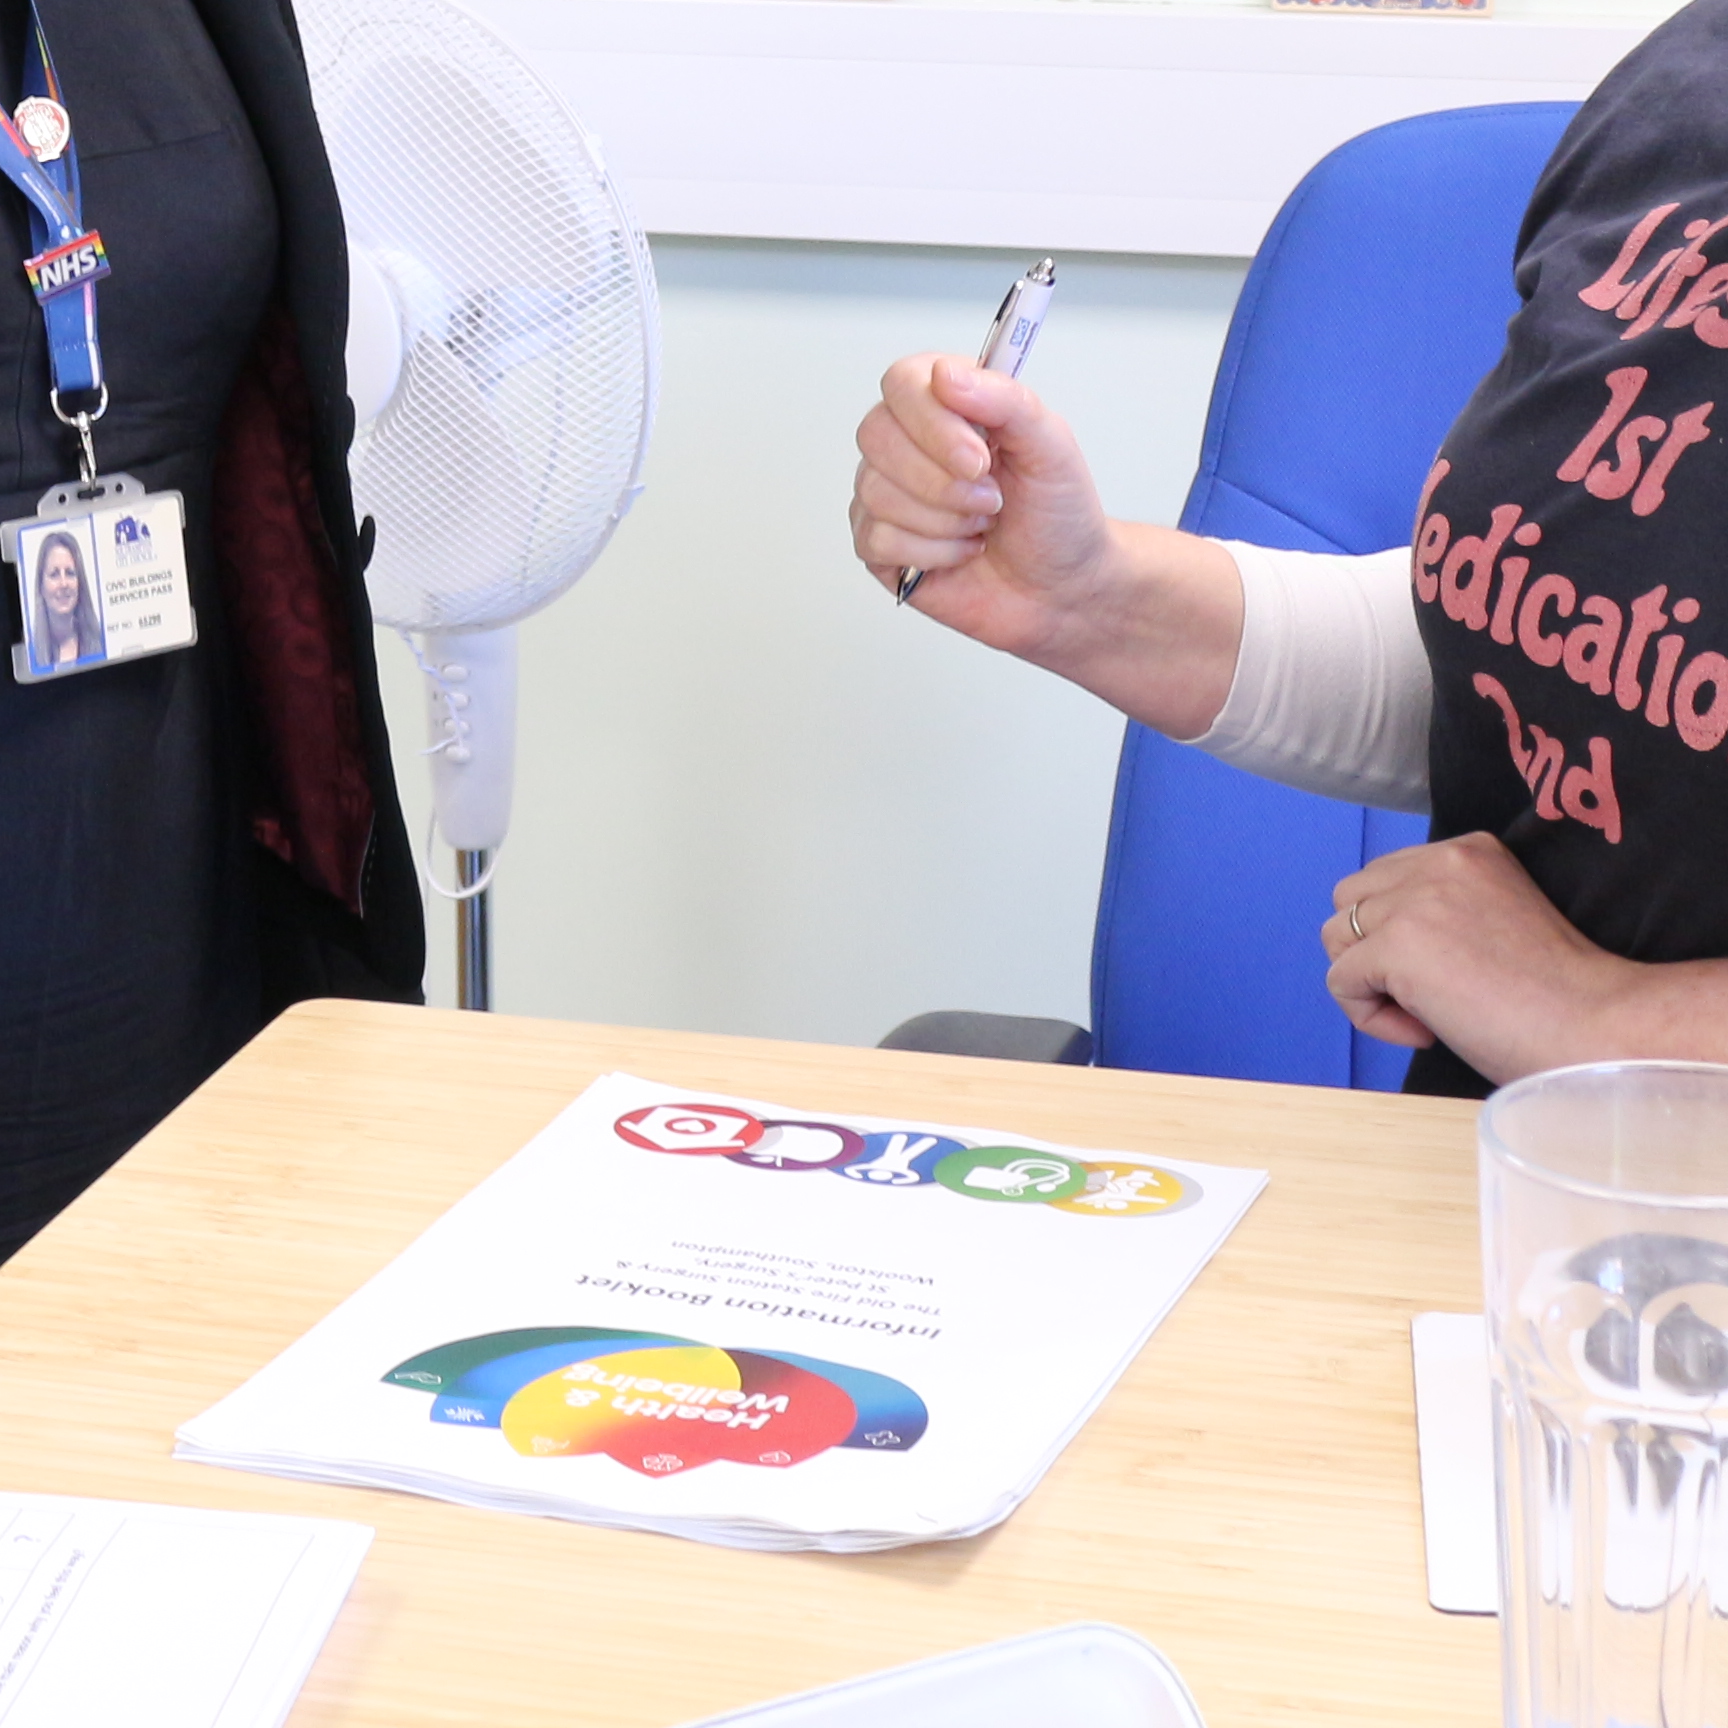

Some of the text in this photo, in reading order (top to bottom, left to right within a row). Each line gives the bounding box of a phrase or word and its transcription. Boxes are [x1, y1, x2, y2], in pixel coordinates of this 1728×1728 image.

[40, 244, 98, 292] NHS
[1556, 366, 1715, 516] 1st
[129, 570, 173, 587] BUILDINGS
[109, 583, 173, 605] SERVICES PASS
[638, 1261, 717, 1286] Surgery
[671, 1239, 934, 1286] Woolston, Southampton
[728, 1276, 803, 1299] Station
[784, 1268, 862, 1290] Peter's
[573, 1274, 942, 1341] Information Booklet
[810, 1288, 851, 1303] Fire
[856, 1295, 896, 1310] Old
[903, 1302, 942, 1317] The
[561, 1363, 790, 1413] Wellbeing
[563, 1389, 772, 1431] Health &
